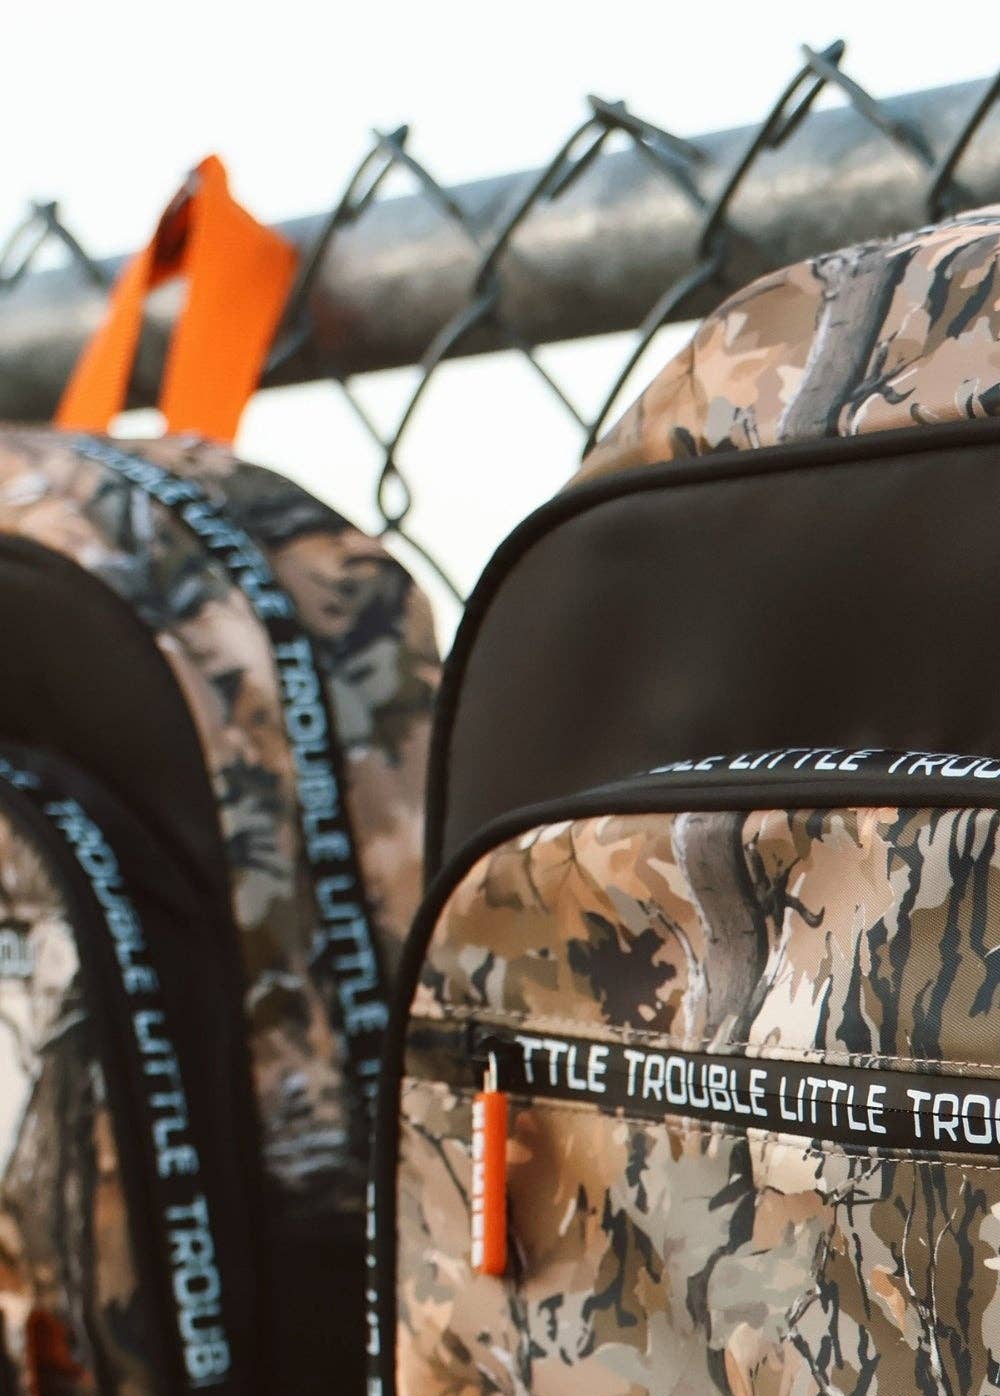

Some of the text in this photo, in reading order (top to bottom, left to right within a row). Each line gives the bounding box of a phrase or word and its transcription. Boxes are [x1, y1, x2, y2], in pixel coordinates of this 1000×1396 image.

[277, 637, 350, 863] TROUBLE
[316, 875, 390, 1035] LITTLE
[134, 1010, 200, 1177] LITTLE
[515, 1035, 610, 1094] TTLE
[623, 1049, 768, 1118] TROUBLE
[779, 1075, 887, 1135] LITTLE
